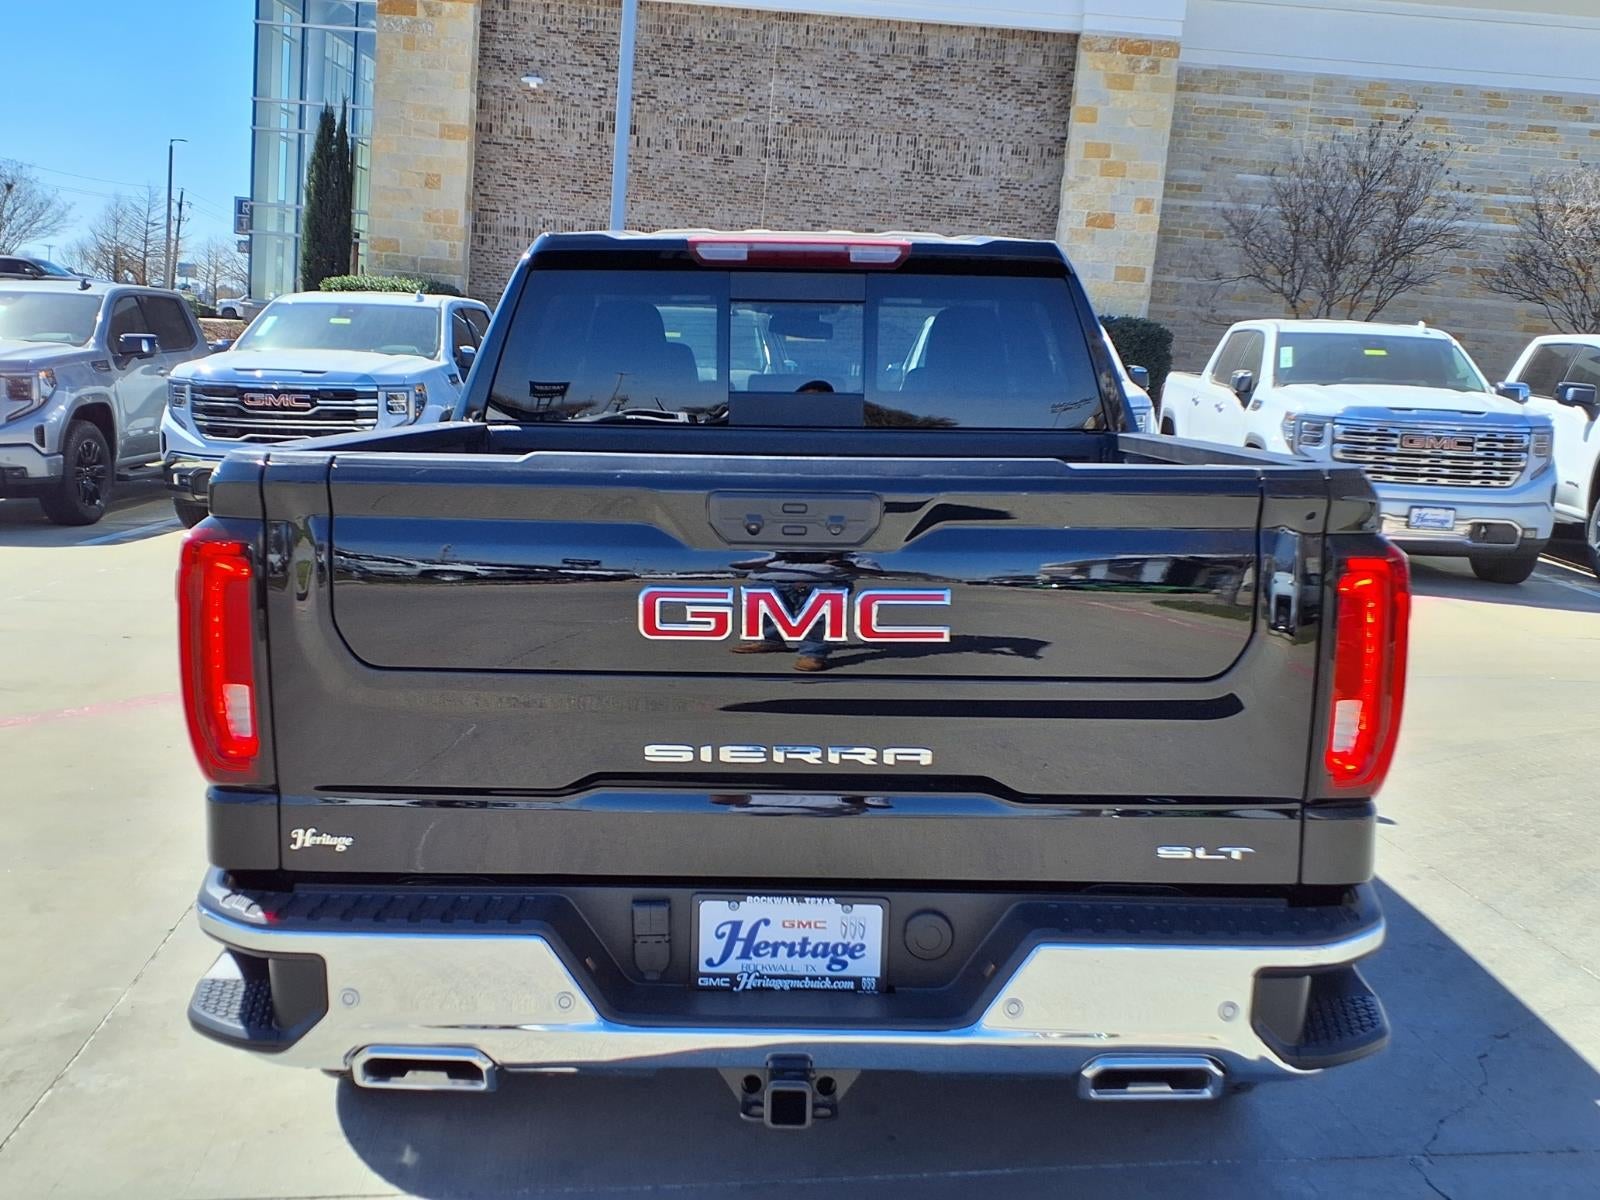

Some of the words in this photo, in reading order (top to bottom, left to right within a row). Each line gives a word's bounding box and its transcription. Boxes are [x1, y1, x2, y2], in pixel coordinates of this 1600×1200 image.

[244, 392, 311, 408] GMC
[1402, 434, 1473, 451] GMC
[637, 586, 951, 643] GMC
[643, 744, 933, 766] SIERRA
[290, 827, 354, 852] Heritage
[1156, 846, 1256, 861] SLT
[781, 920, 827, 930] GMC
[705, 918, 866, 972] Heritage
[698, 977, 730, 986] GMC
